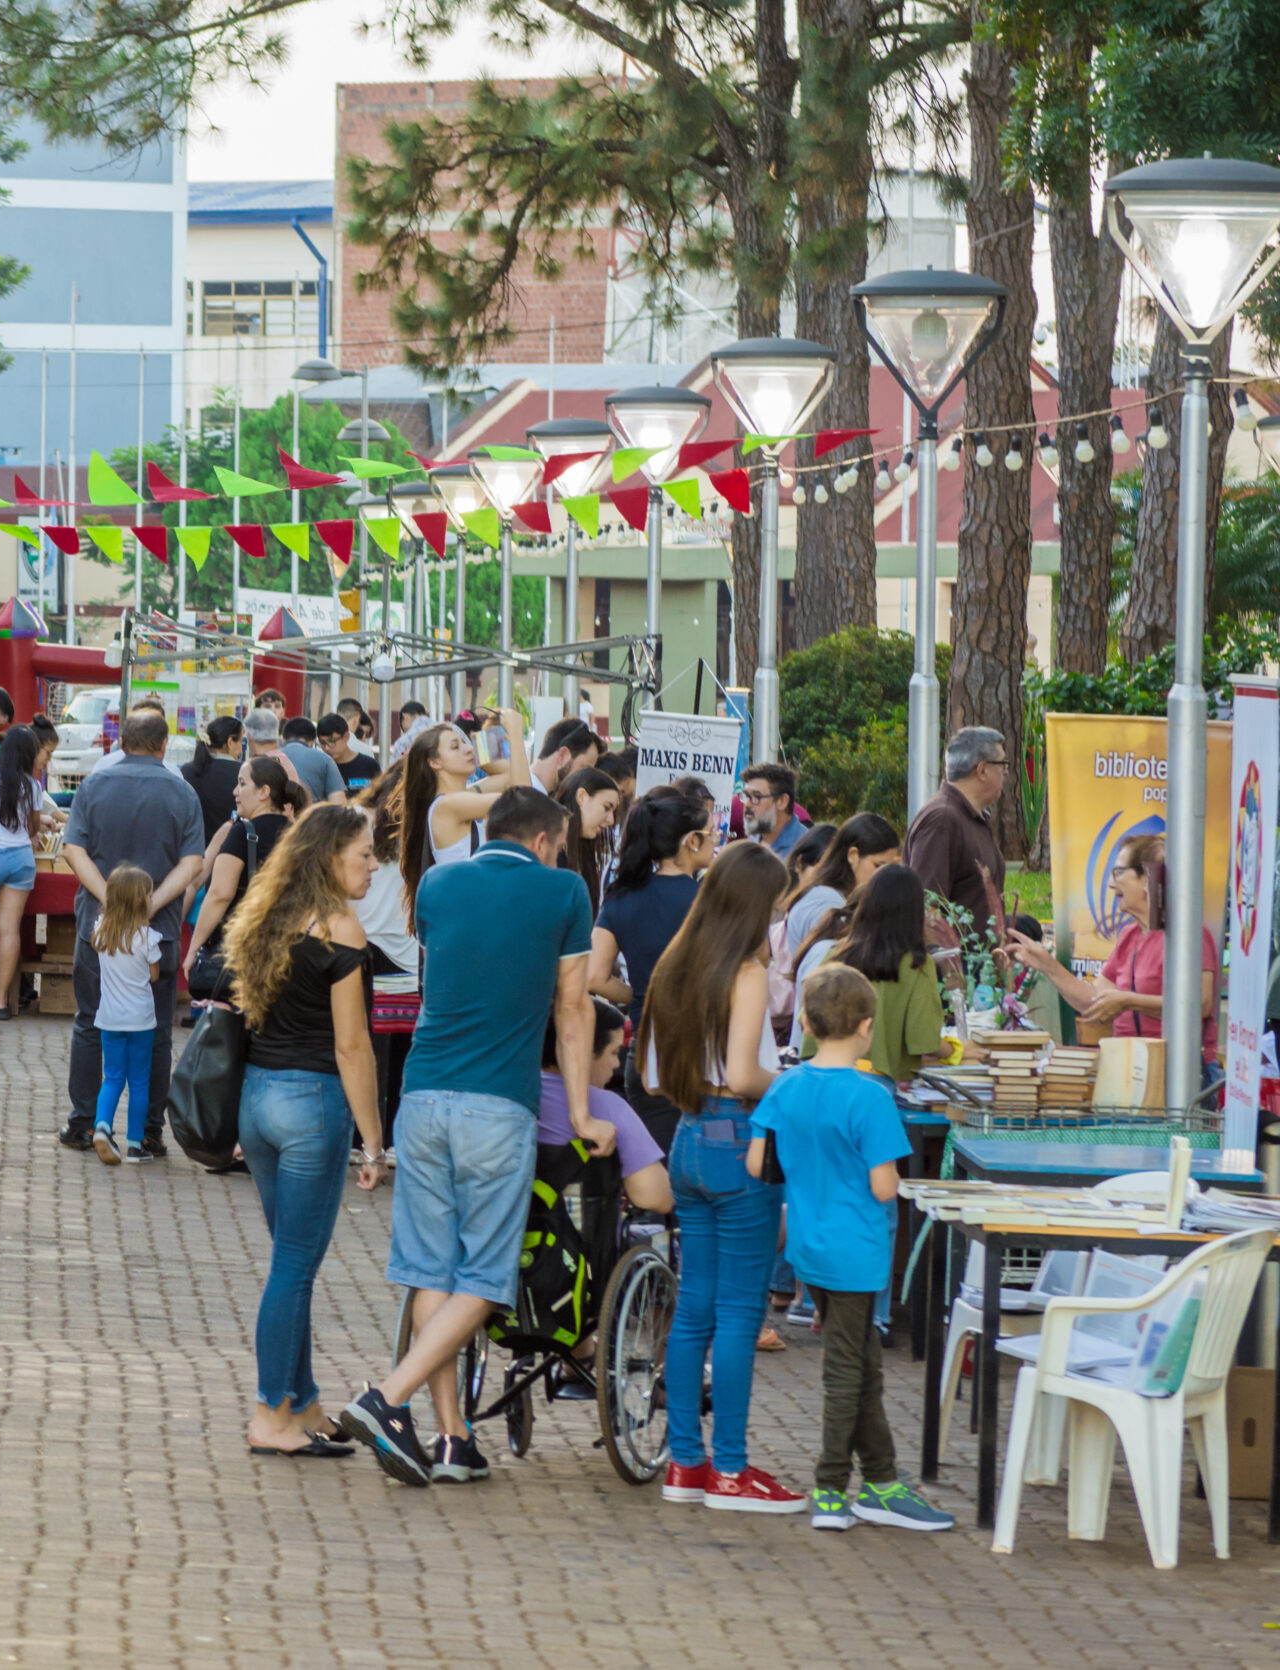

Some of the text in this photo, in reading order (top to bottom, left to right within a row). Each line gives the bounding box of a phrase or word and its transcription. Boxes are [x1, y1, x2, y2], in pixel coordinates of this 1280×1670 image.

[640, 747, 734, 776] MAXIS BENN
[1094, 750, 1168, 780] bibliote
[1143, 786, 1168, 804] pop
